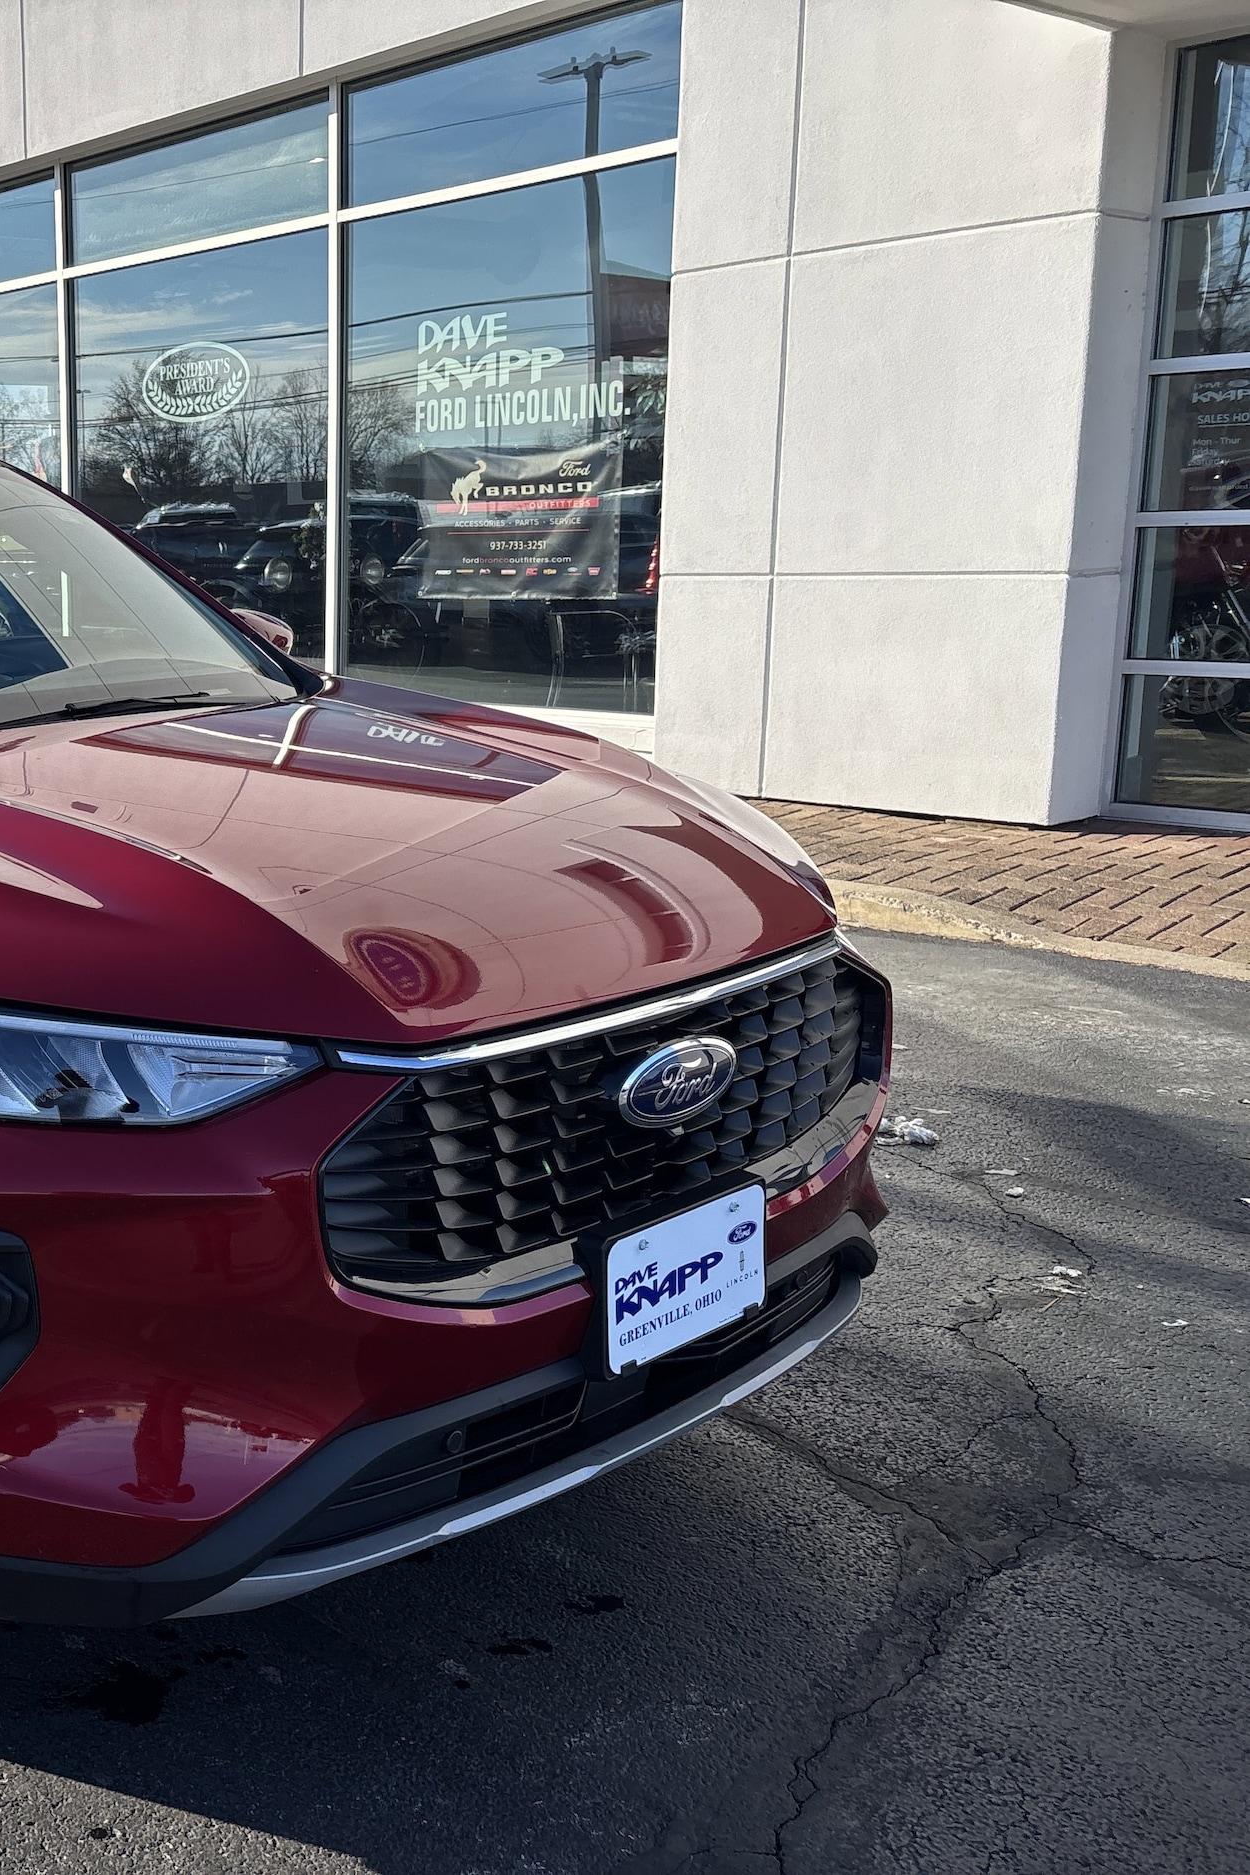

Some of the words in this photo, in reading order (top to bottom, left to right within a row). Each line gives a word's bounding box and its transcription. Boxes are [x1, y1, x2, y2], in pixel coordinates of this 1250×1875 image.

[417, 311, 508, 355] DAVE
[159, 357, 230, 381] PRESIDENT'S
[416, 346, 565, 396] KNAPP
[174, 376, 215, 396] AWARD
[414, 396, 467, 433] FORD
[1197, 413, 1230, 425] SALES
[1192, 438, 1213, 447] Mon
[1220, 436, 1241, 445] Thur
[1191, 447, 1219, 457] Friday
[558, 460, 592, 478] Ford
[485, 481, 593, 497] BRONCO
[529, 499, 591, 510] OUTFITTERS
[454, 518, 506, 528] ACCESSORIES
[515, 518, 540, 527] PARTS
[549, 516, 582, 526] SERVICE
[489, 540, 548, 551] 937-733-3251
[461, 555, 572, 565] fordbroncooutfitters.com
[654, 1057, 718, 1112] Ford
[732, 1224, 752, 1242] Ford
[614, 1260, 658, 1296] DAVE
[726, 1268, 759, 1288] LINCOLN
[615, 1251, 724, 1326] KNAPP
[619, 1303, 693, 1347] GREENVILLE,
[695, 1288, 723, 1312] OHIO
